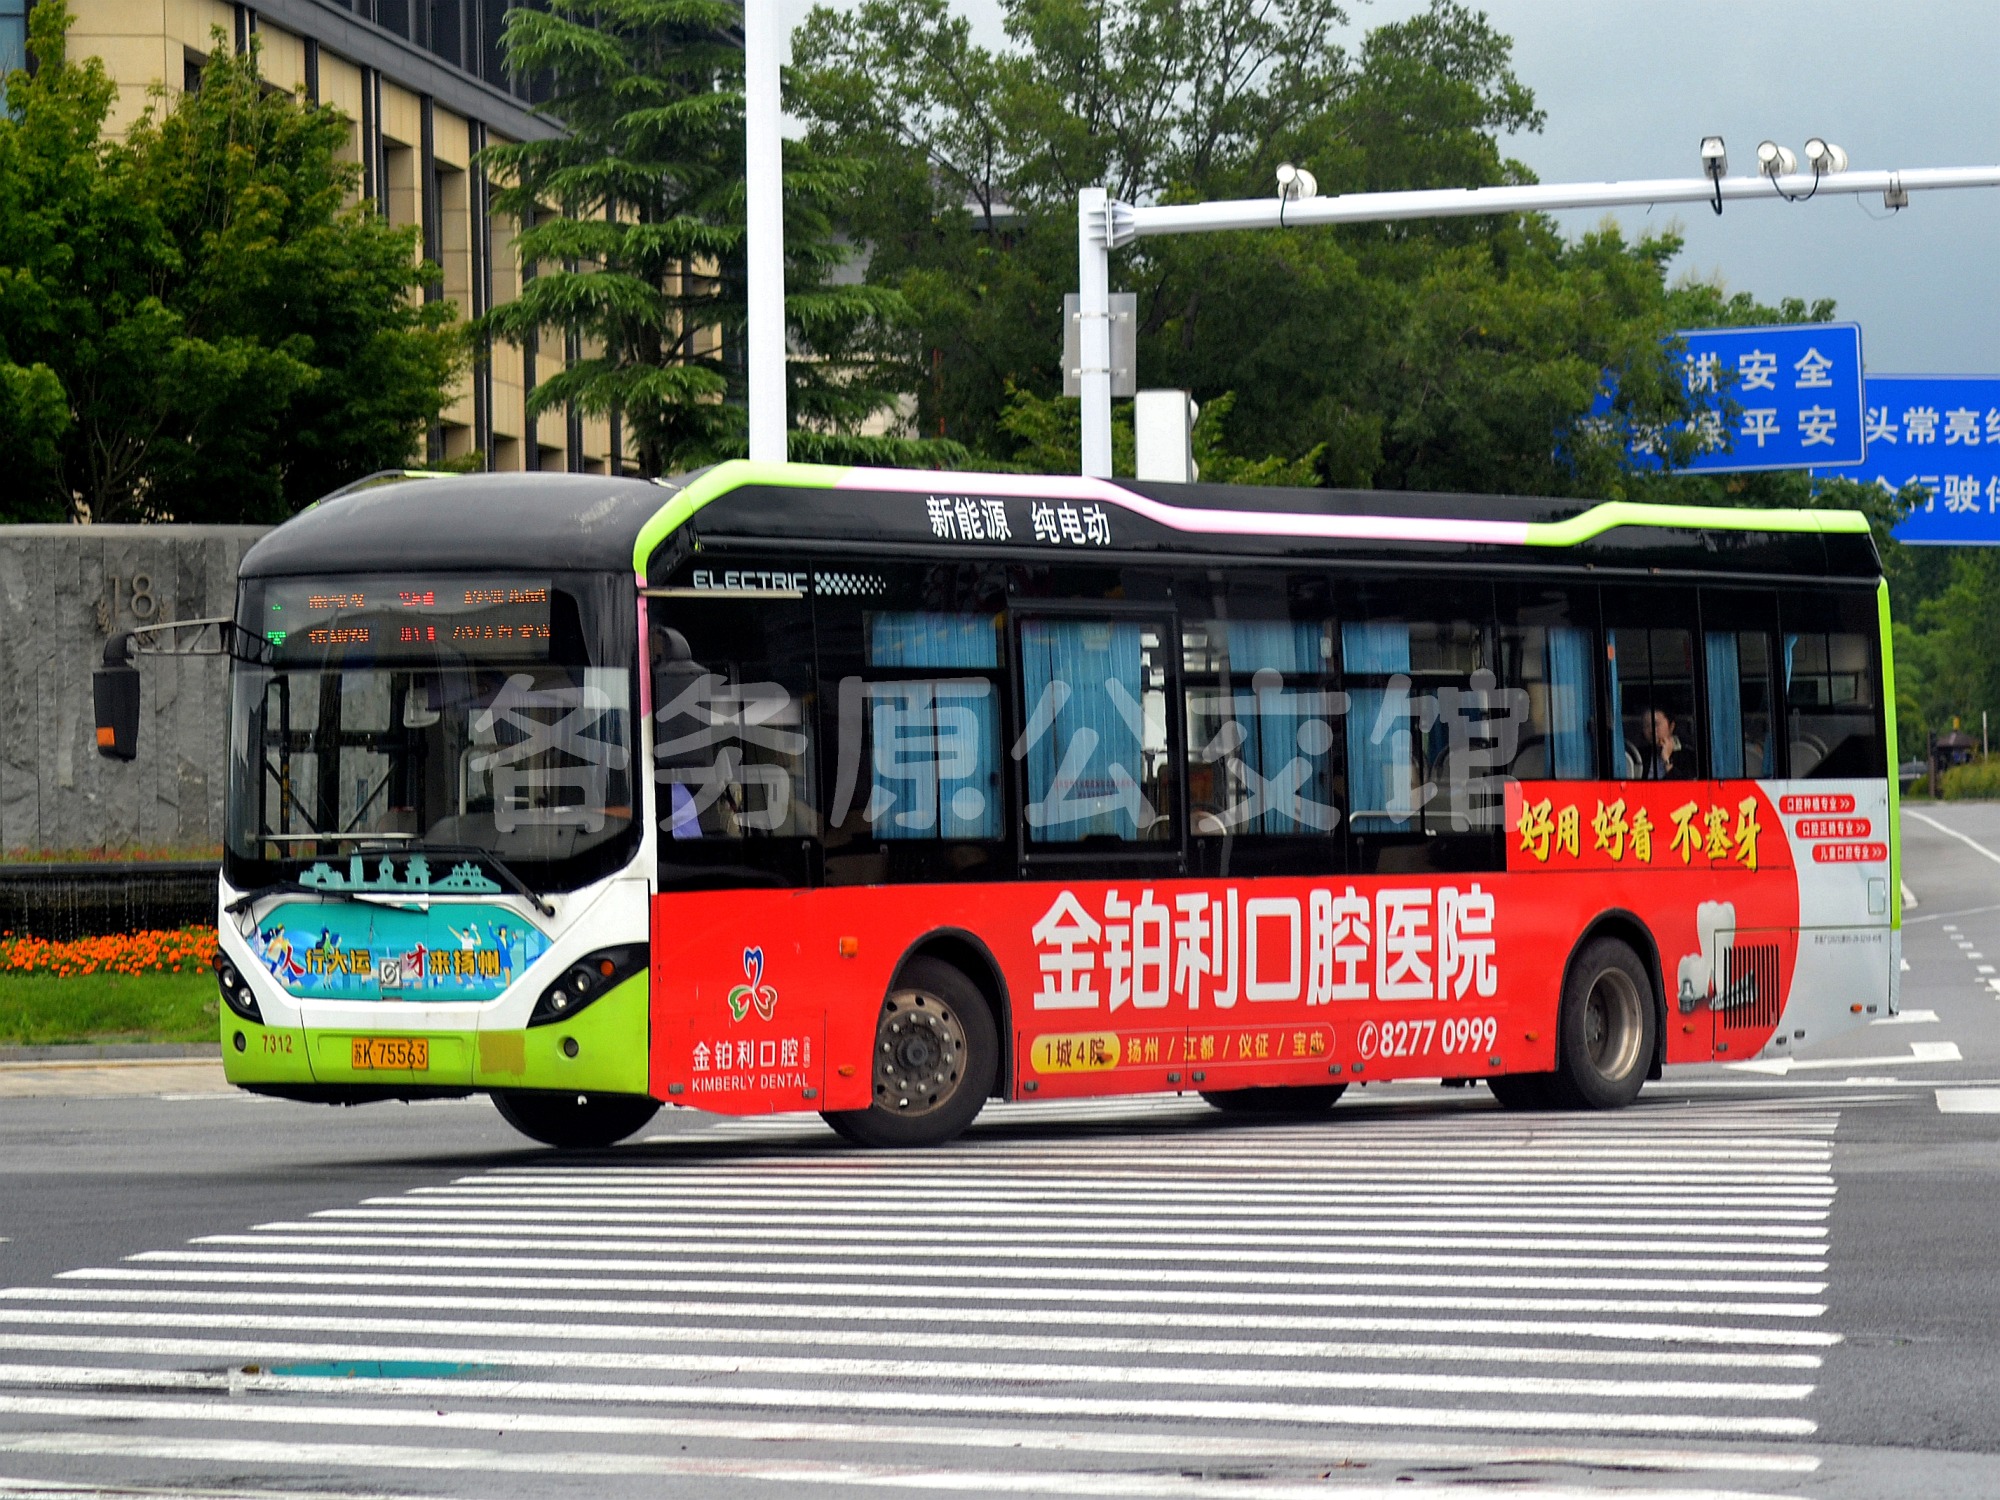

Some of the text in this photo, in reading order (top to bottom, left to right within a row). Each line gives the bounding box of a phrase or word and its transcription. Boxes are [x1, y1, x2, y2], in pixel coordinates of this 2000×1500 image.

[926, 496, 1112, 546] 新能源 纯电动
[108, 572, 156, 619] 18
[693, 569, 808, 593] ELECTRIC
[1516, 796, 1762, 871] 好用 好看 不塞牙
[281, 942, 500, 979] 人行大运 才来扬州
[1031, 884, 1498, 1012] 金铂利口腔医院
[261, 1035, 292, 1054] 7312
[692, 1037, 799, 1072] 金铂利口腔
[1127, 1037, 1159, 1064] 扬州
[1182, 1035, 1214, 1062] 江都
[1237, 1032, 1269, 1059] 仪征
[1380, 1017, 1498, 1059] 8277 0999
[691, 1072, 809, 1093] KIMBERLY DENTAL
